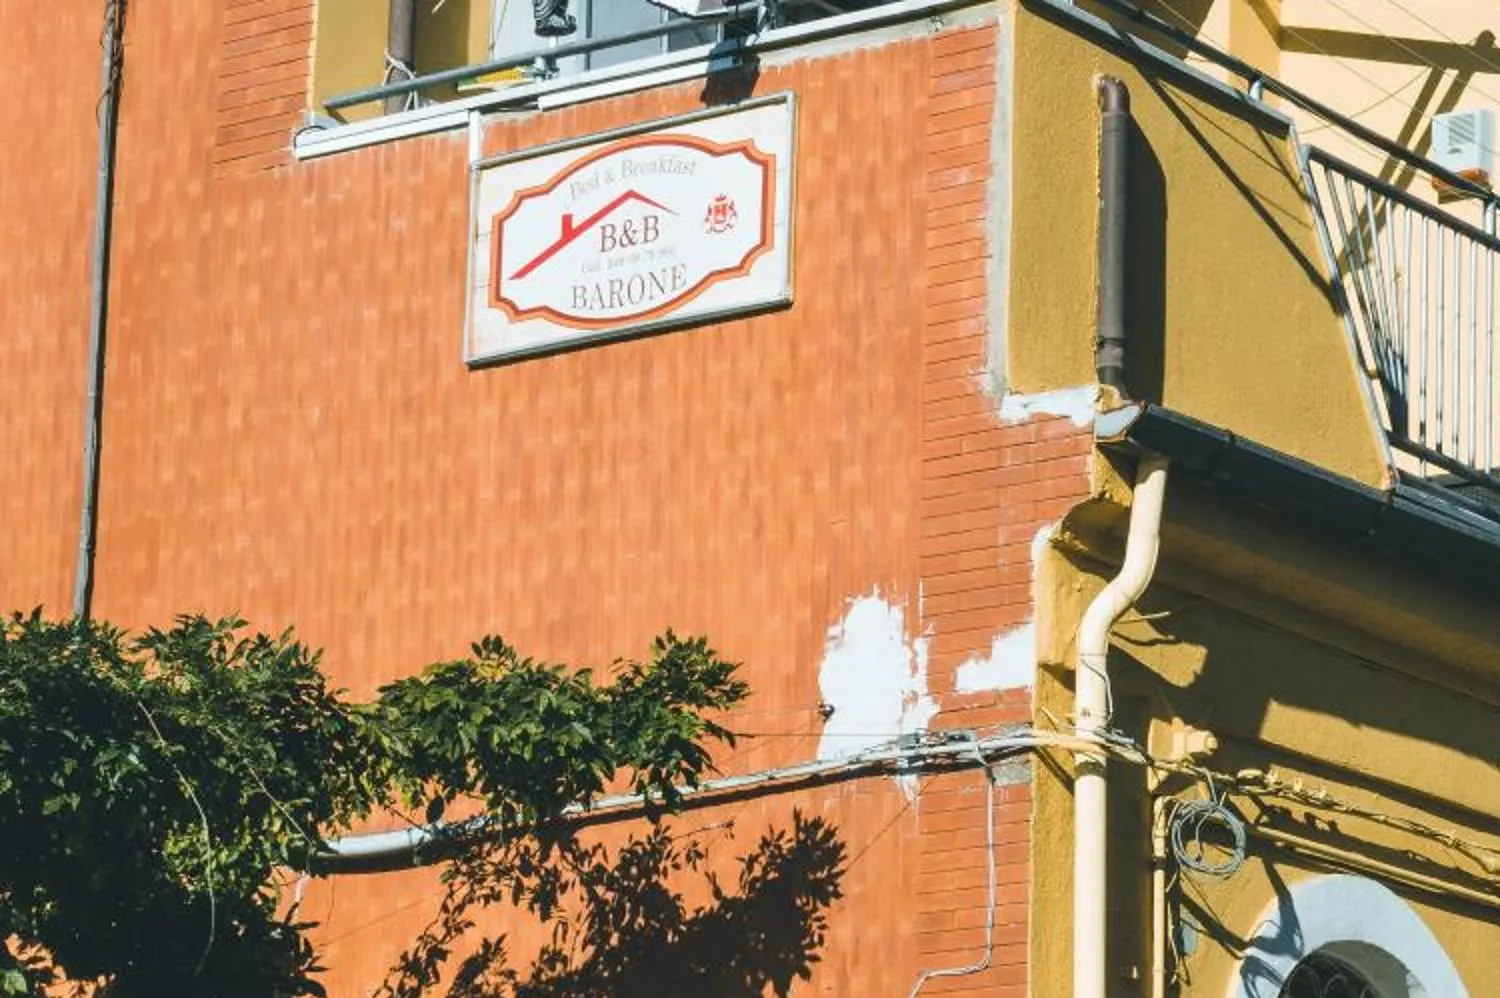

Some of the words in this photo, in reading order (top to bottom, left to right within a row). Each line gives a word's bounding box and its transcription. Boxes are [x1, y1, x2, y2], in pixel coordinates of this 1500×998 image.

[621, 158, 696, 179] Breakfast
[600, 215, 659, 252] B&B
[571, 263, 687, 310] BARONE
